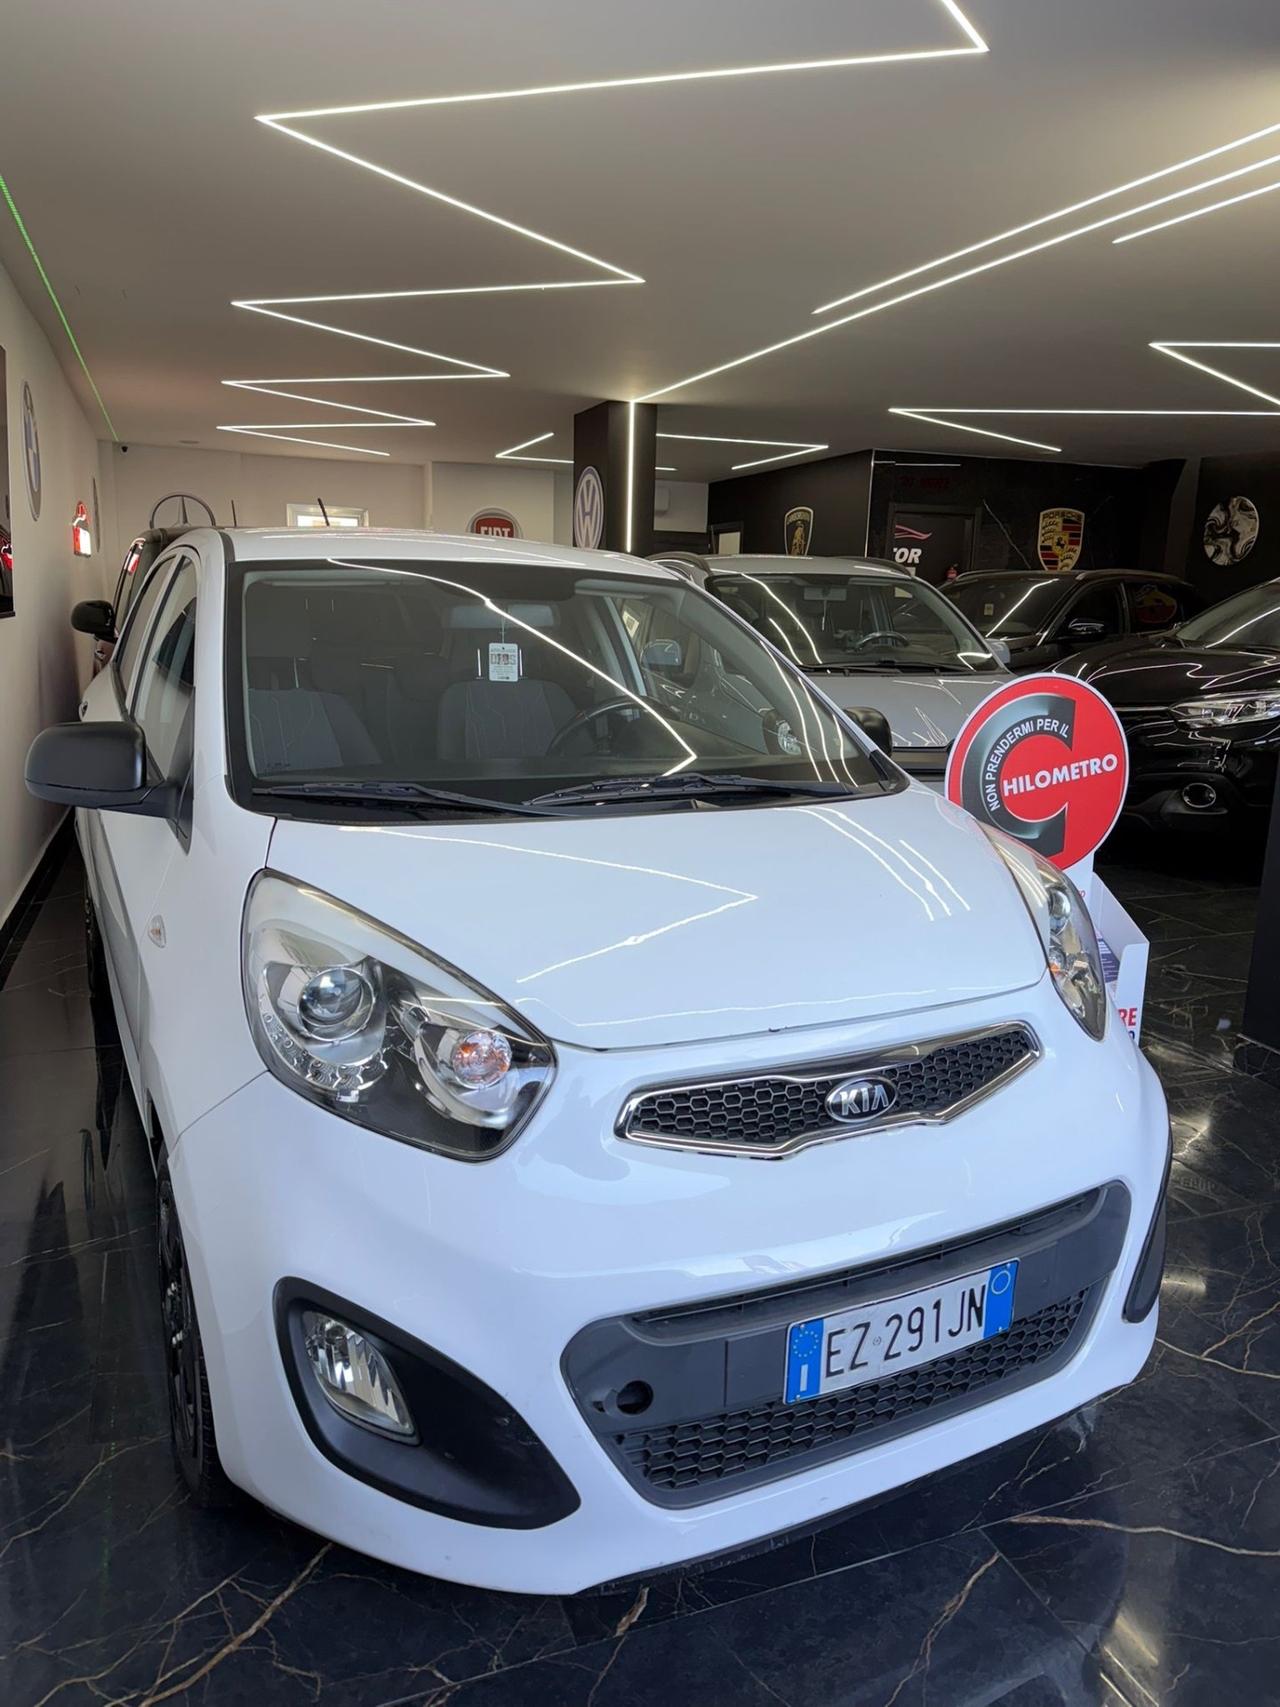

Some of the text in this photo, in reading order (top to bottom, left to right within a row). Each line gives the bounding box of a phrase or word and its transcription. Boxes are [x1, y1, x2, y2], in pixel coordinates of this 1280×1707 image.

[893, 547, 922, 564] OR
[985, 718, 1069, 811] NON PRENDERMI PER IL
[1003, 753, 1118, 797] HILOMETRO
[839, 1084, 889, 1116] KIA
[825, 1321, 870, 1378] EZ
